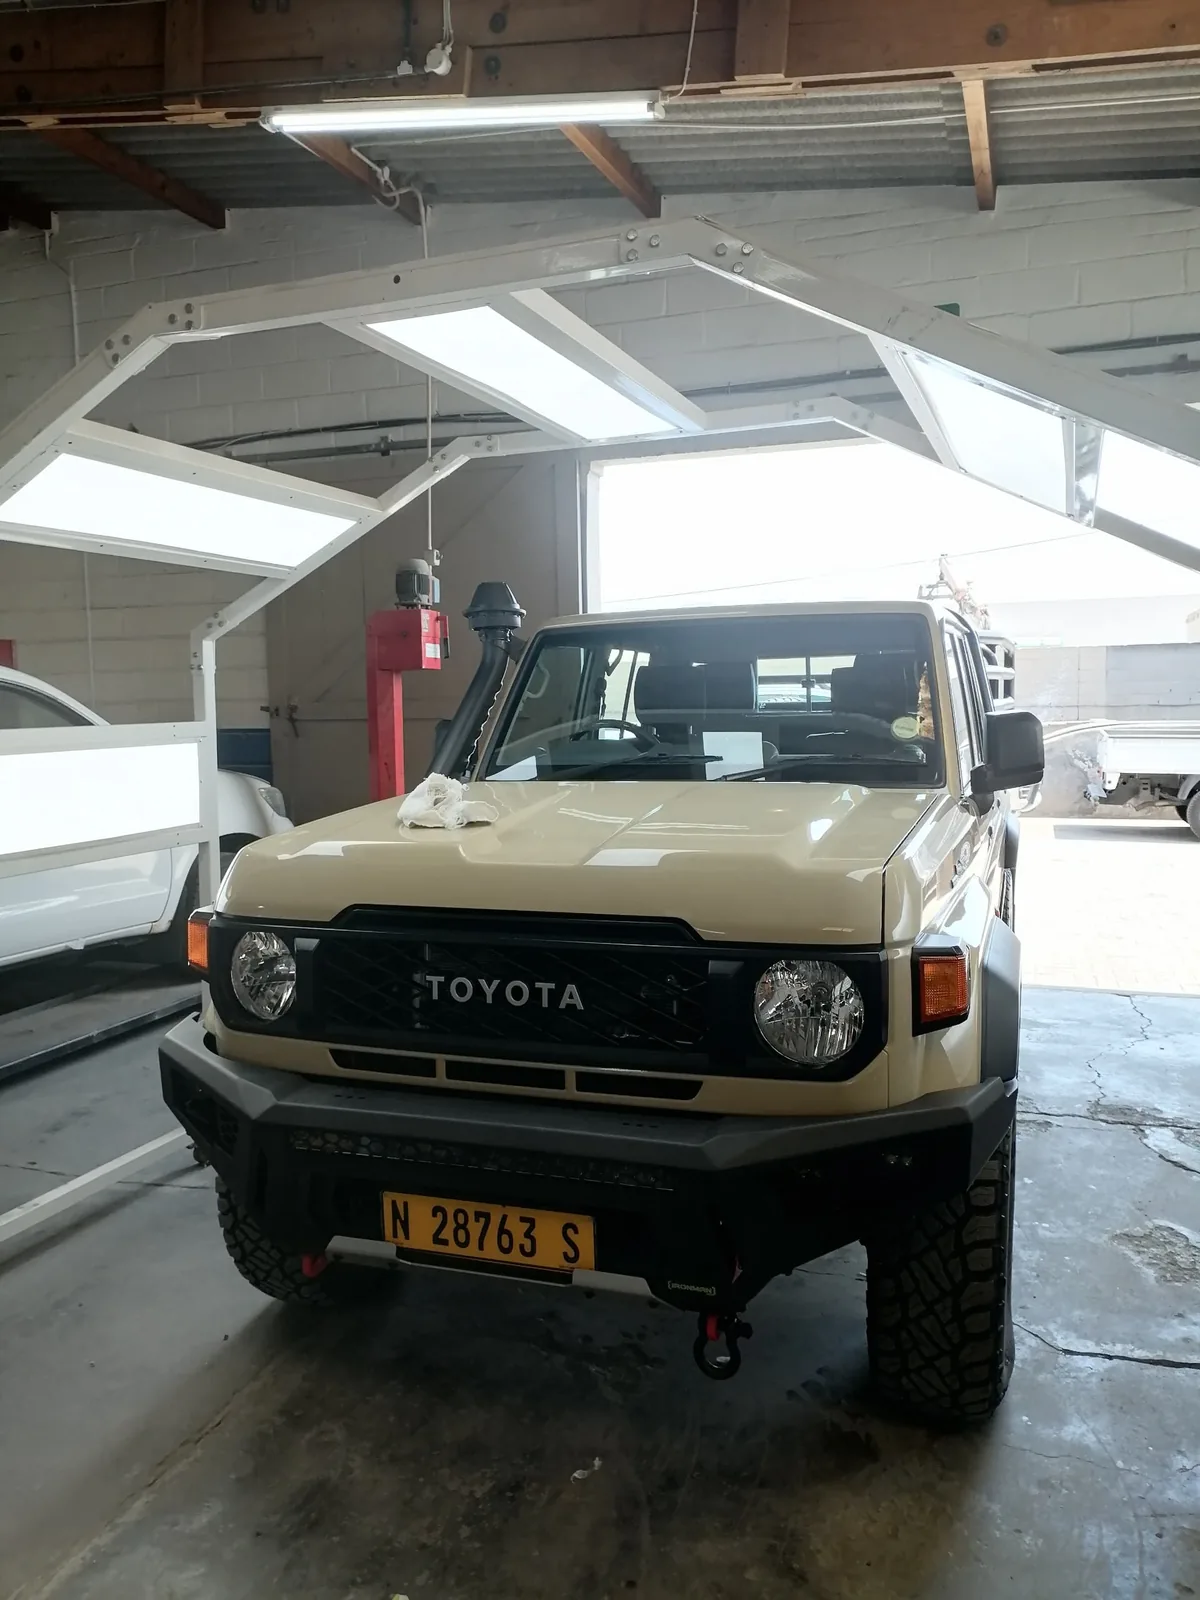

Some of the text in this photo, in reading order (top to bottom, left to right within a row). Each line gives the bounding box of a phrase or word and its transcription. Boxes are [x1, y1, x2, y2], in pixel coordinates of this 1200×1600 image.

[425, 975, 584, 1010] TOYOTA
[391, 1199, 580, 1264] N 28763 S
